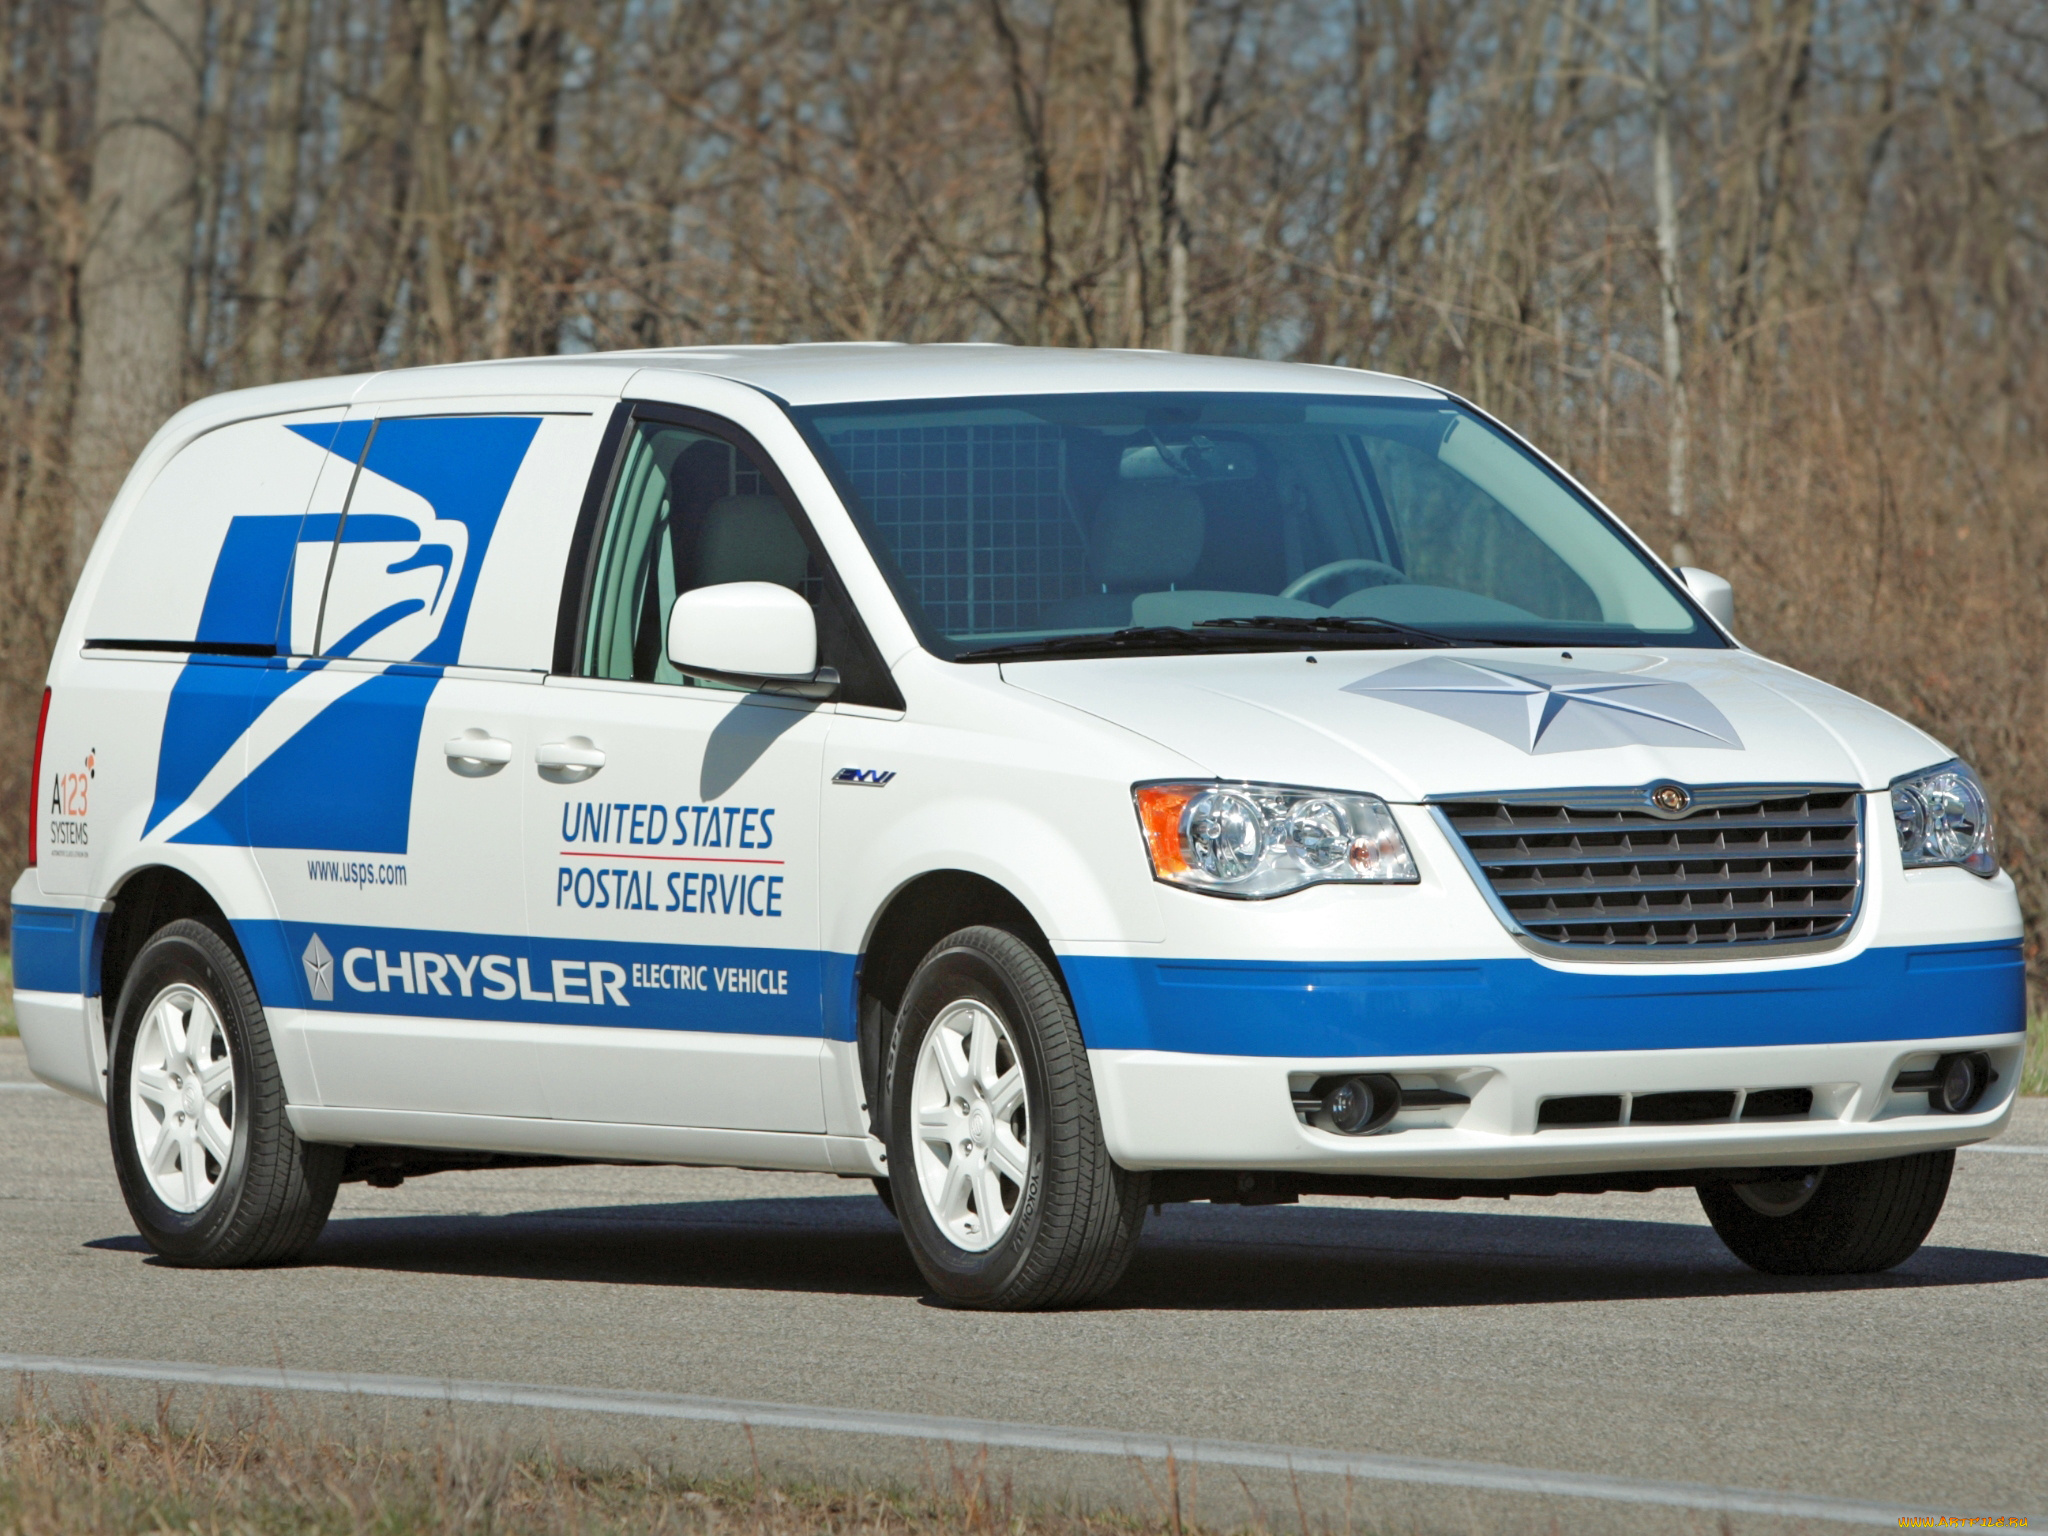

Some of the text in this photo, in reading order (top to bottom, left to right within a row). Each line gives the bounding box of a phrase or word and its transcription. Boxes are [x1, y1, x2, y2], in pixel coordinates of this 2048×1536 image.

[51, 773, 88, 816] A123
[51, 821, 88, 845] SYSTEMS
[562, 802, 775, 849] UNITED STATES
[307, 860, 407, 890] www.usps.com
[557, 867, 784, 917] POSTAL SERVICE
[342, 947, 630, 1007] CHRYSLER
[632, 963, 788, 995] ELECTRIC VEHICLE
